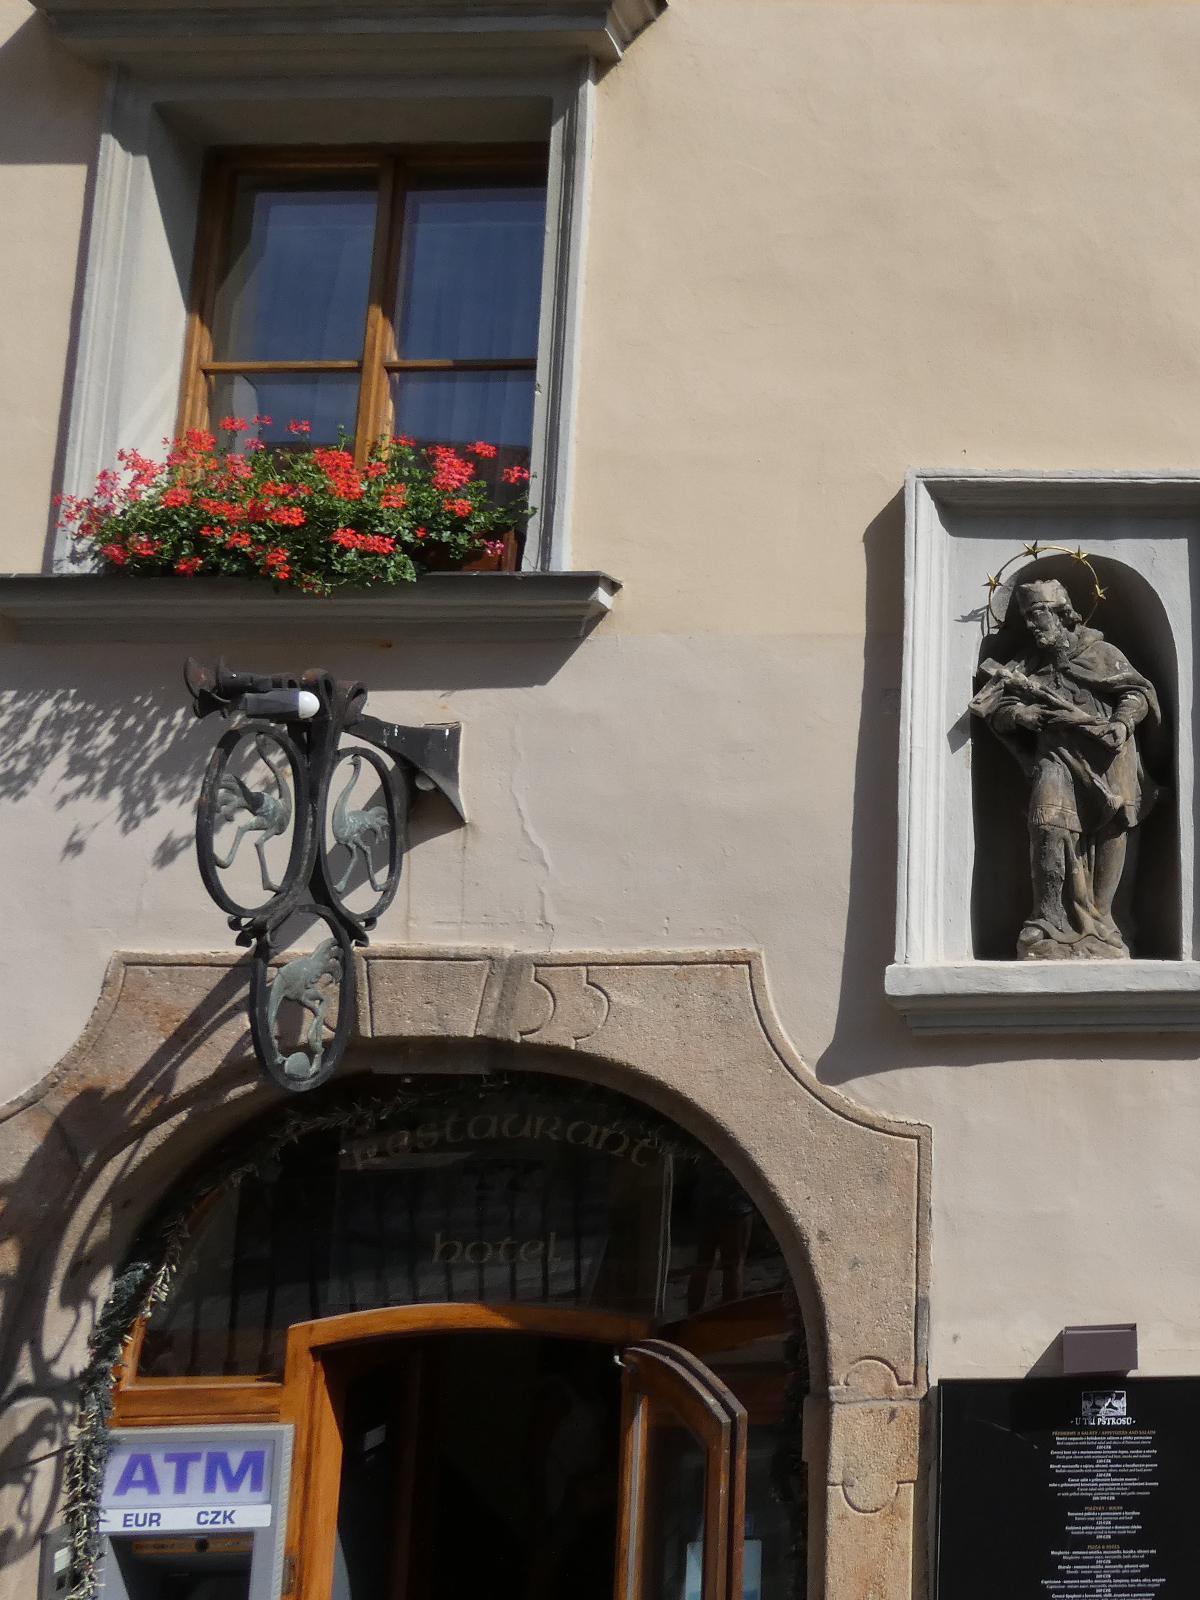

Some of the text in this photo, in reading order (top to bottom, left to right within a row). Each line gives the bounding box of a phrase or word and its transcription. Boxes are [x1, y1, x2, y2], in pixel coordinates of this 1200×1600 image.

[431, 1231, 562, 1265] hotel
[113, 1449, 266, 1496] ATM
[122, 1509, 236, 1528] EUR CZK
